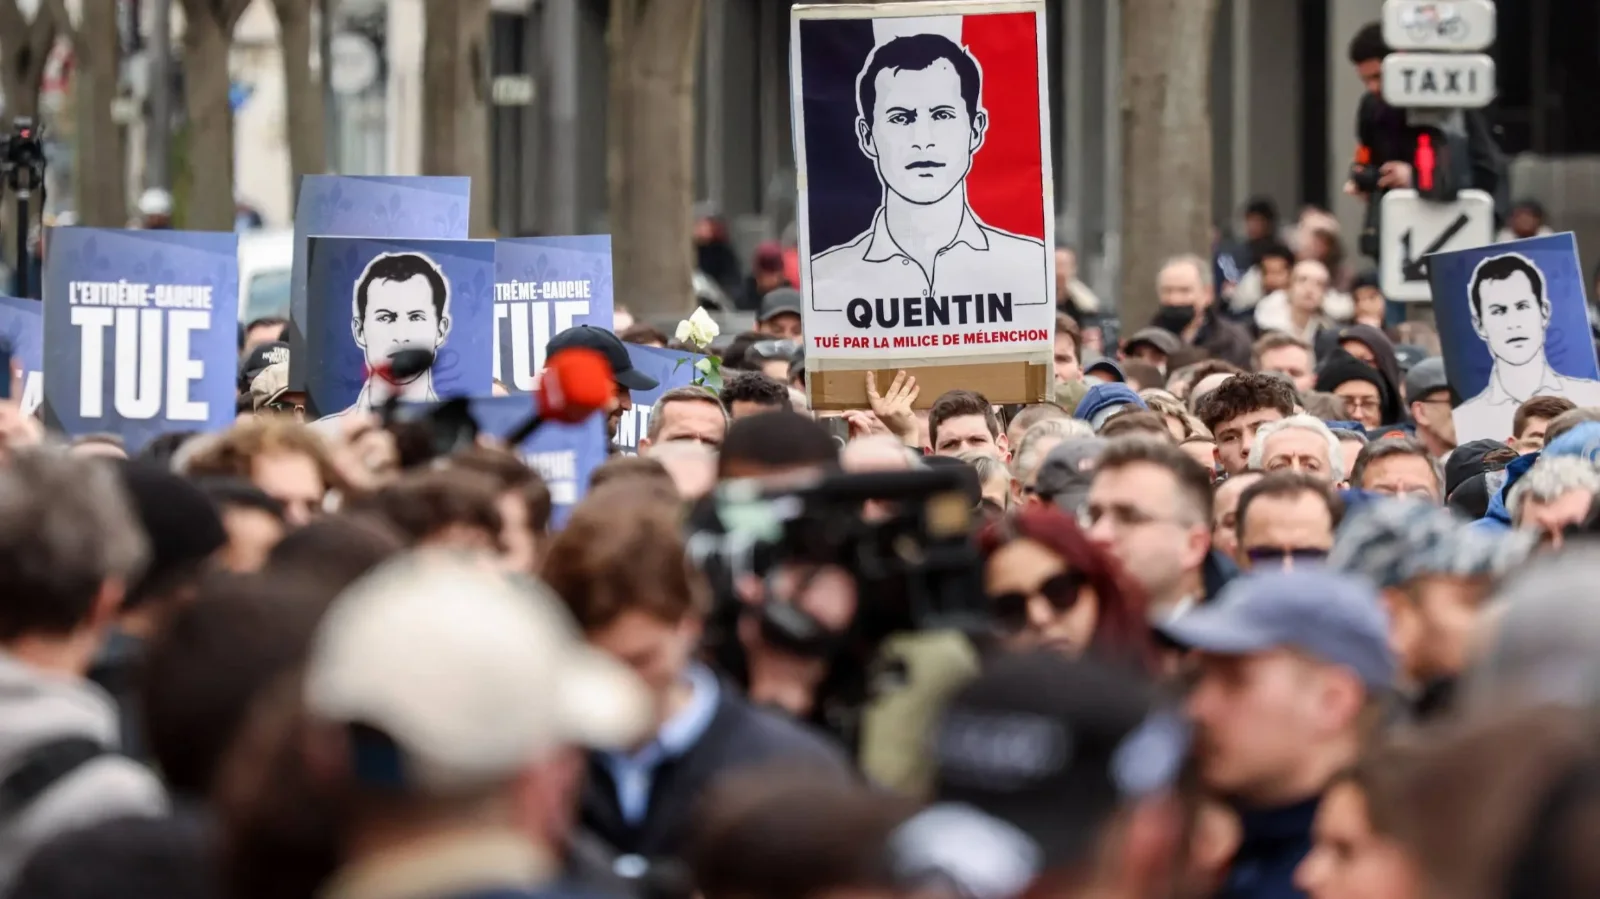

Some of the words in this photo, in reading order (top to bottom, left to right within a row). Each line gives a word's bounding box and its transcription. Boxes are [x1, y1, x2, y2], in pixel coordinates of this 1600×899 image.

[1400, 69, 1477, 93] TAXI
[493, 279, 591, 301] TRÊME-GAUCHE
[846, 293, 1013, 329] QUENTIN
[814, 334, 840, 348] TUÉ
[843, 337, 870, 348] PAR
[873, 337, 890, 348] LA
[893, 335, 939, 348] MILICE
[942, 334, 960, 345] DE
[963, 329, 1048, 344] MÉLENCHON
[71, 306, 211, 421] TUE
